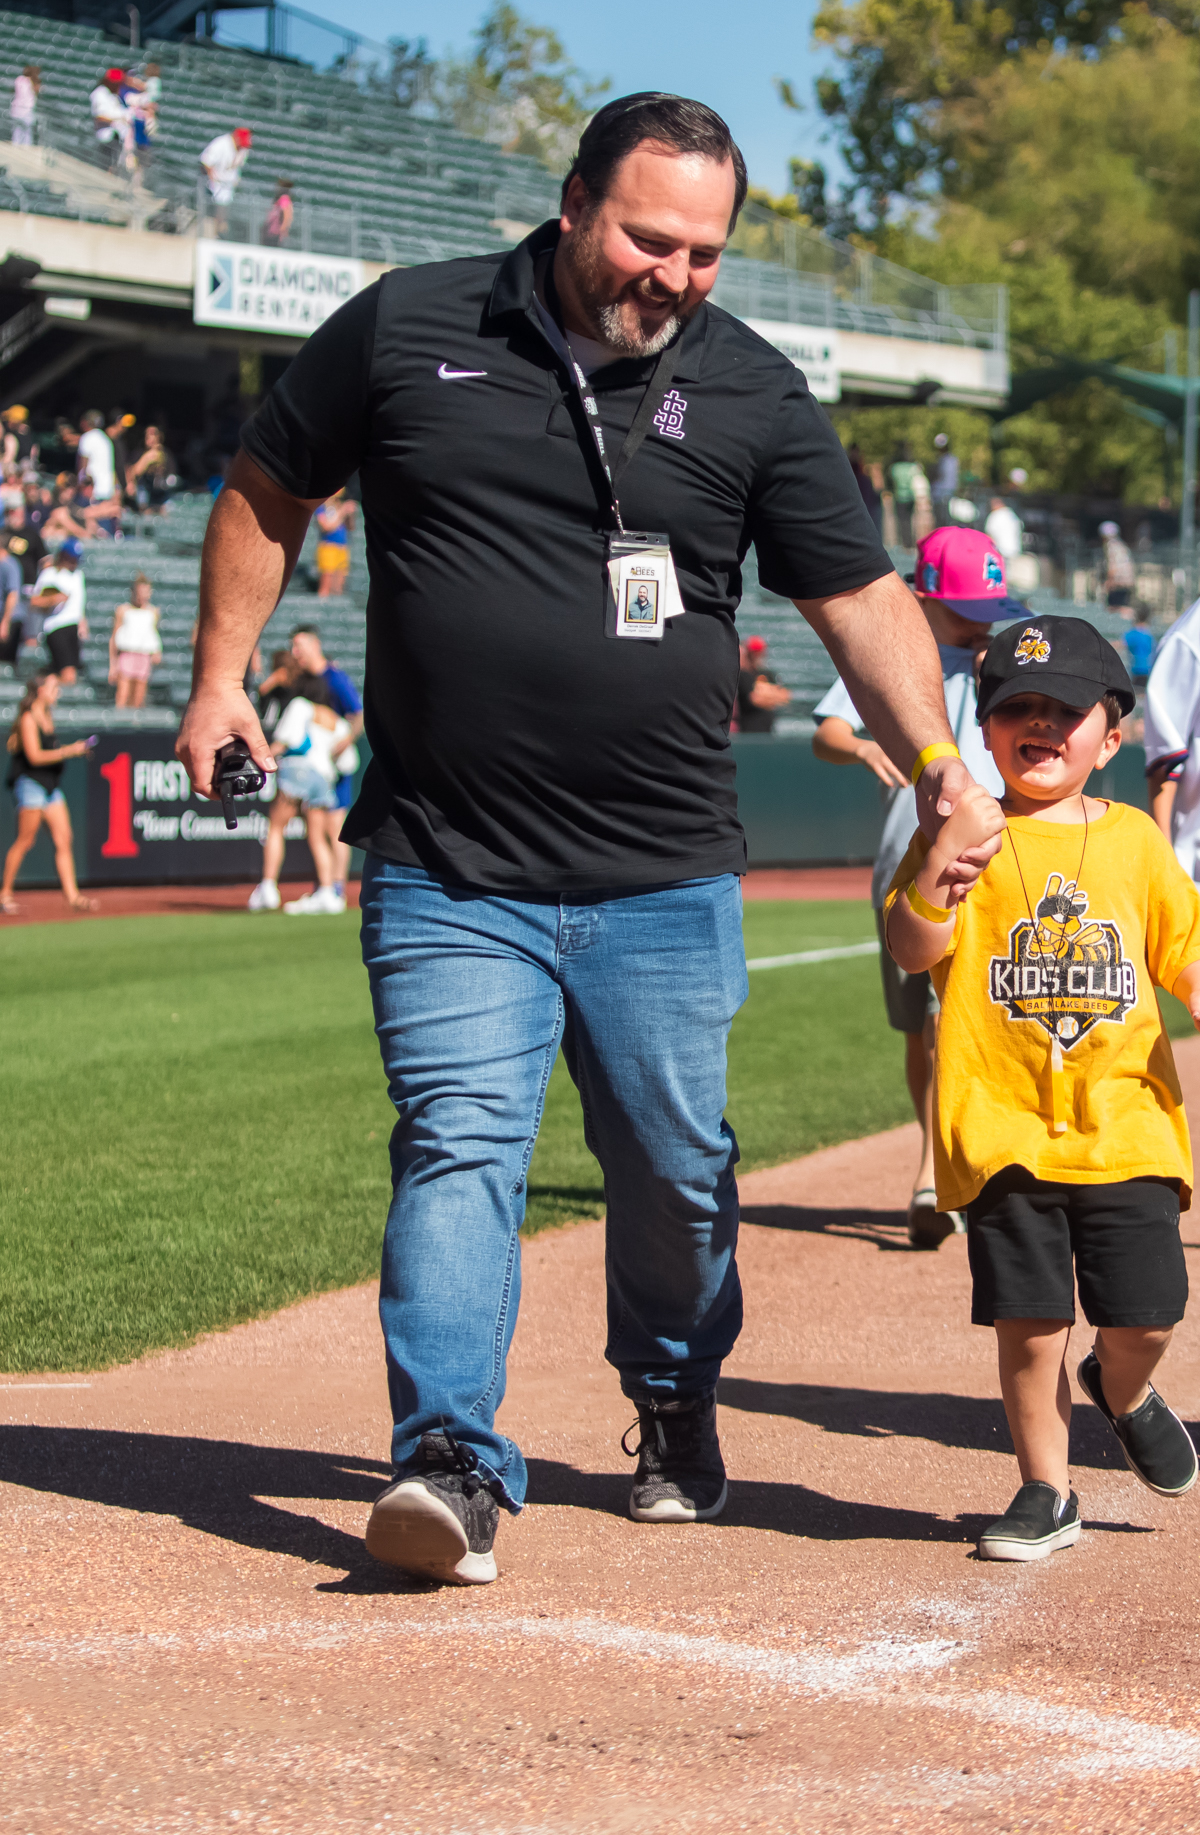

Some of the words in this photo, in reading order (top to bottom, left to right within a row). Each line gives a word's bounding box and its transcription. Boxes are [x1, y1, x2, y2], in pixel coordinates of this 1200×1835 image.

[240, 256, 351, 298] DIAMOND
[133, 760, 191, 802] FIRST
[100, 751, 140, 859] 1
[995, 963, 1060, 998] KIDS
[1067, 964, 1135, 1000] CLUB
[1054, 1000, 1080, 1009] LAKE
[1083, 1001, 1108, 1011] BEES
